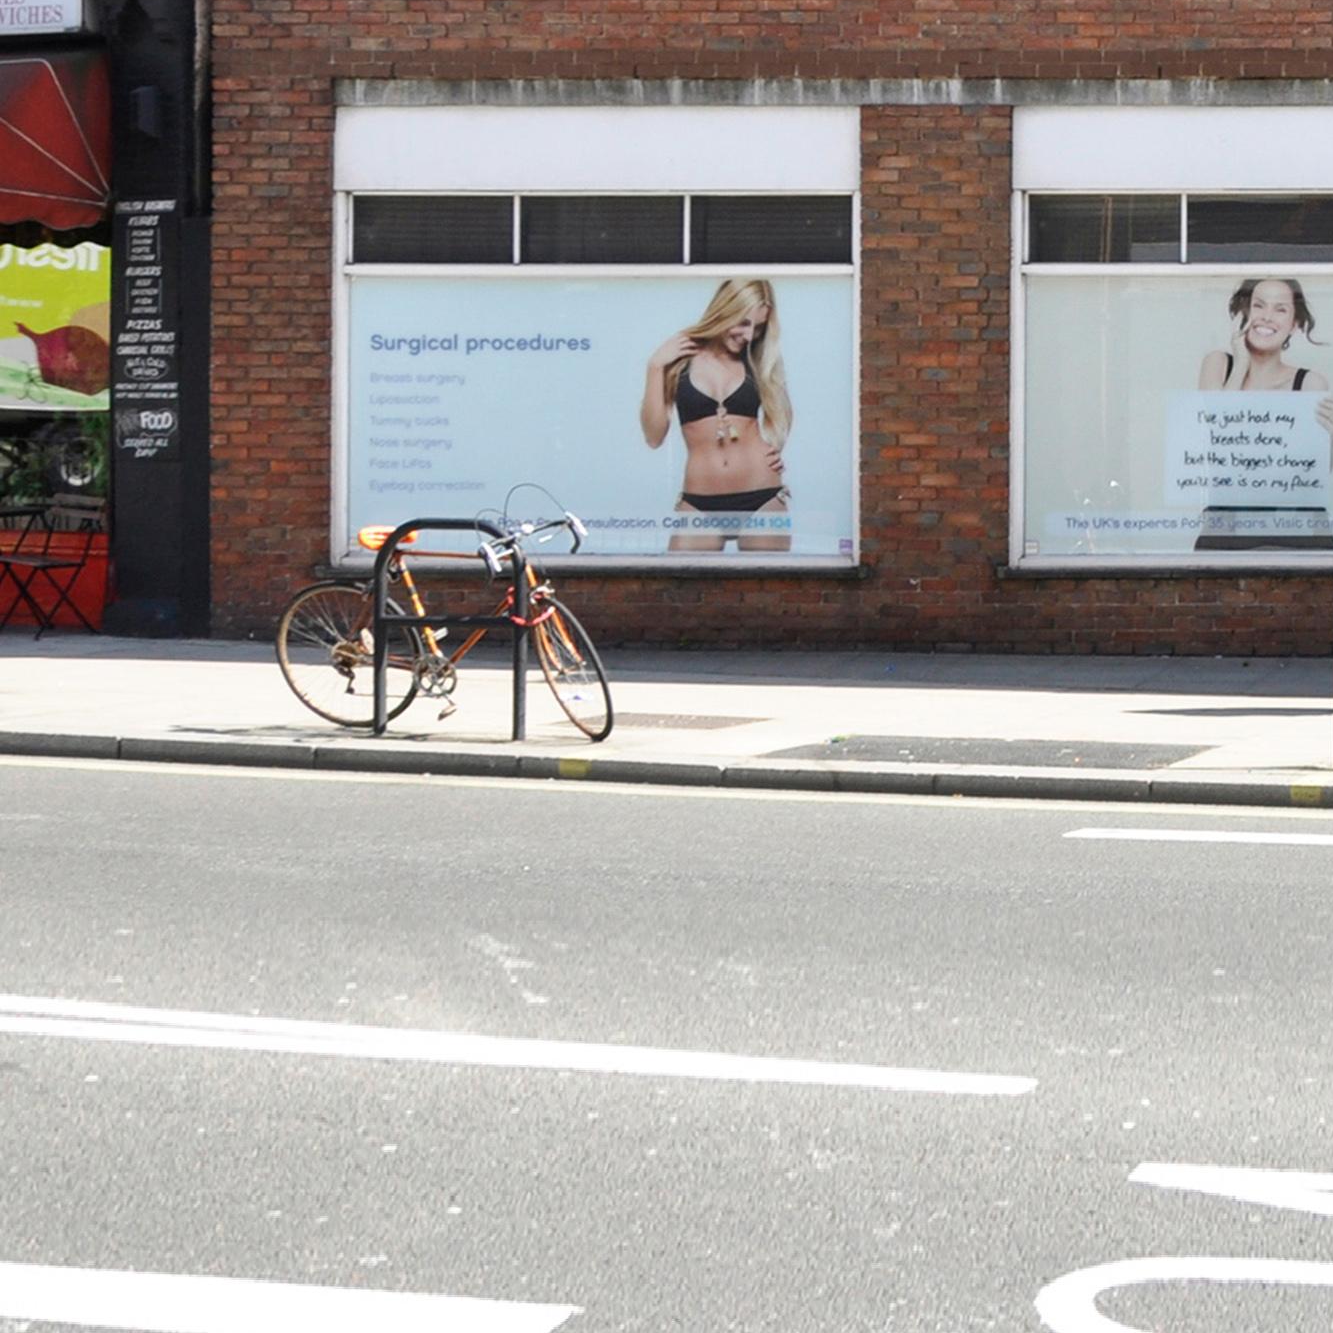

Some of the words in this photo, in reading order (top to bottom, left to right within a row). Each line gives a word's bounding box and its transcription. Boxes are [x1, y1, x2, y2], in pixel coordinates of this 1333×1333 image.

[370, 334, 459, 355] Surgical
[466, 334, 591, 355] procedures
[416, 374, 466, 386] surgery
[140, 411, 173, 430] FOOD
[1219, 410, 1245, 429] just
[1247, 409, 1271, 423] had
[1184, 450, 1205, 465] but
[1207, 451, 1226, 466] the
[1231, 452, 1274, 471] biggest
[1277, 453, 1317, 472] change
[1212, 476, 1233, 488] see
[1237, 474, 1248, 488] is
[1251, 478, 1267, 489] on
[582, 517, 657, 529] onsultation.
[662, 516, 689, 529] Call
[1066, 517, 1089, 529] The
[1093, 517, 1120, 529] UK's
[1124, 518, 1178, 531] experts
[1208, 517, 1223, 529] 35
[1273, 517, 1304, 529] Visit
